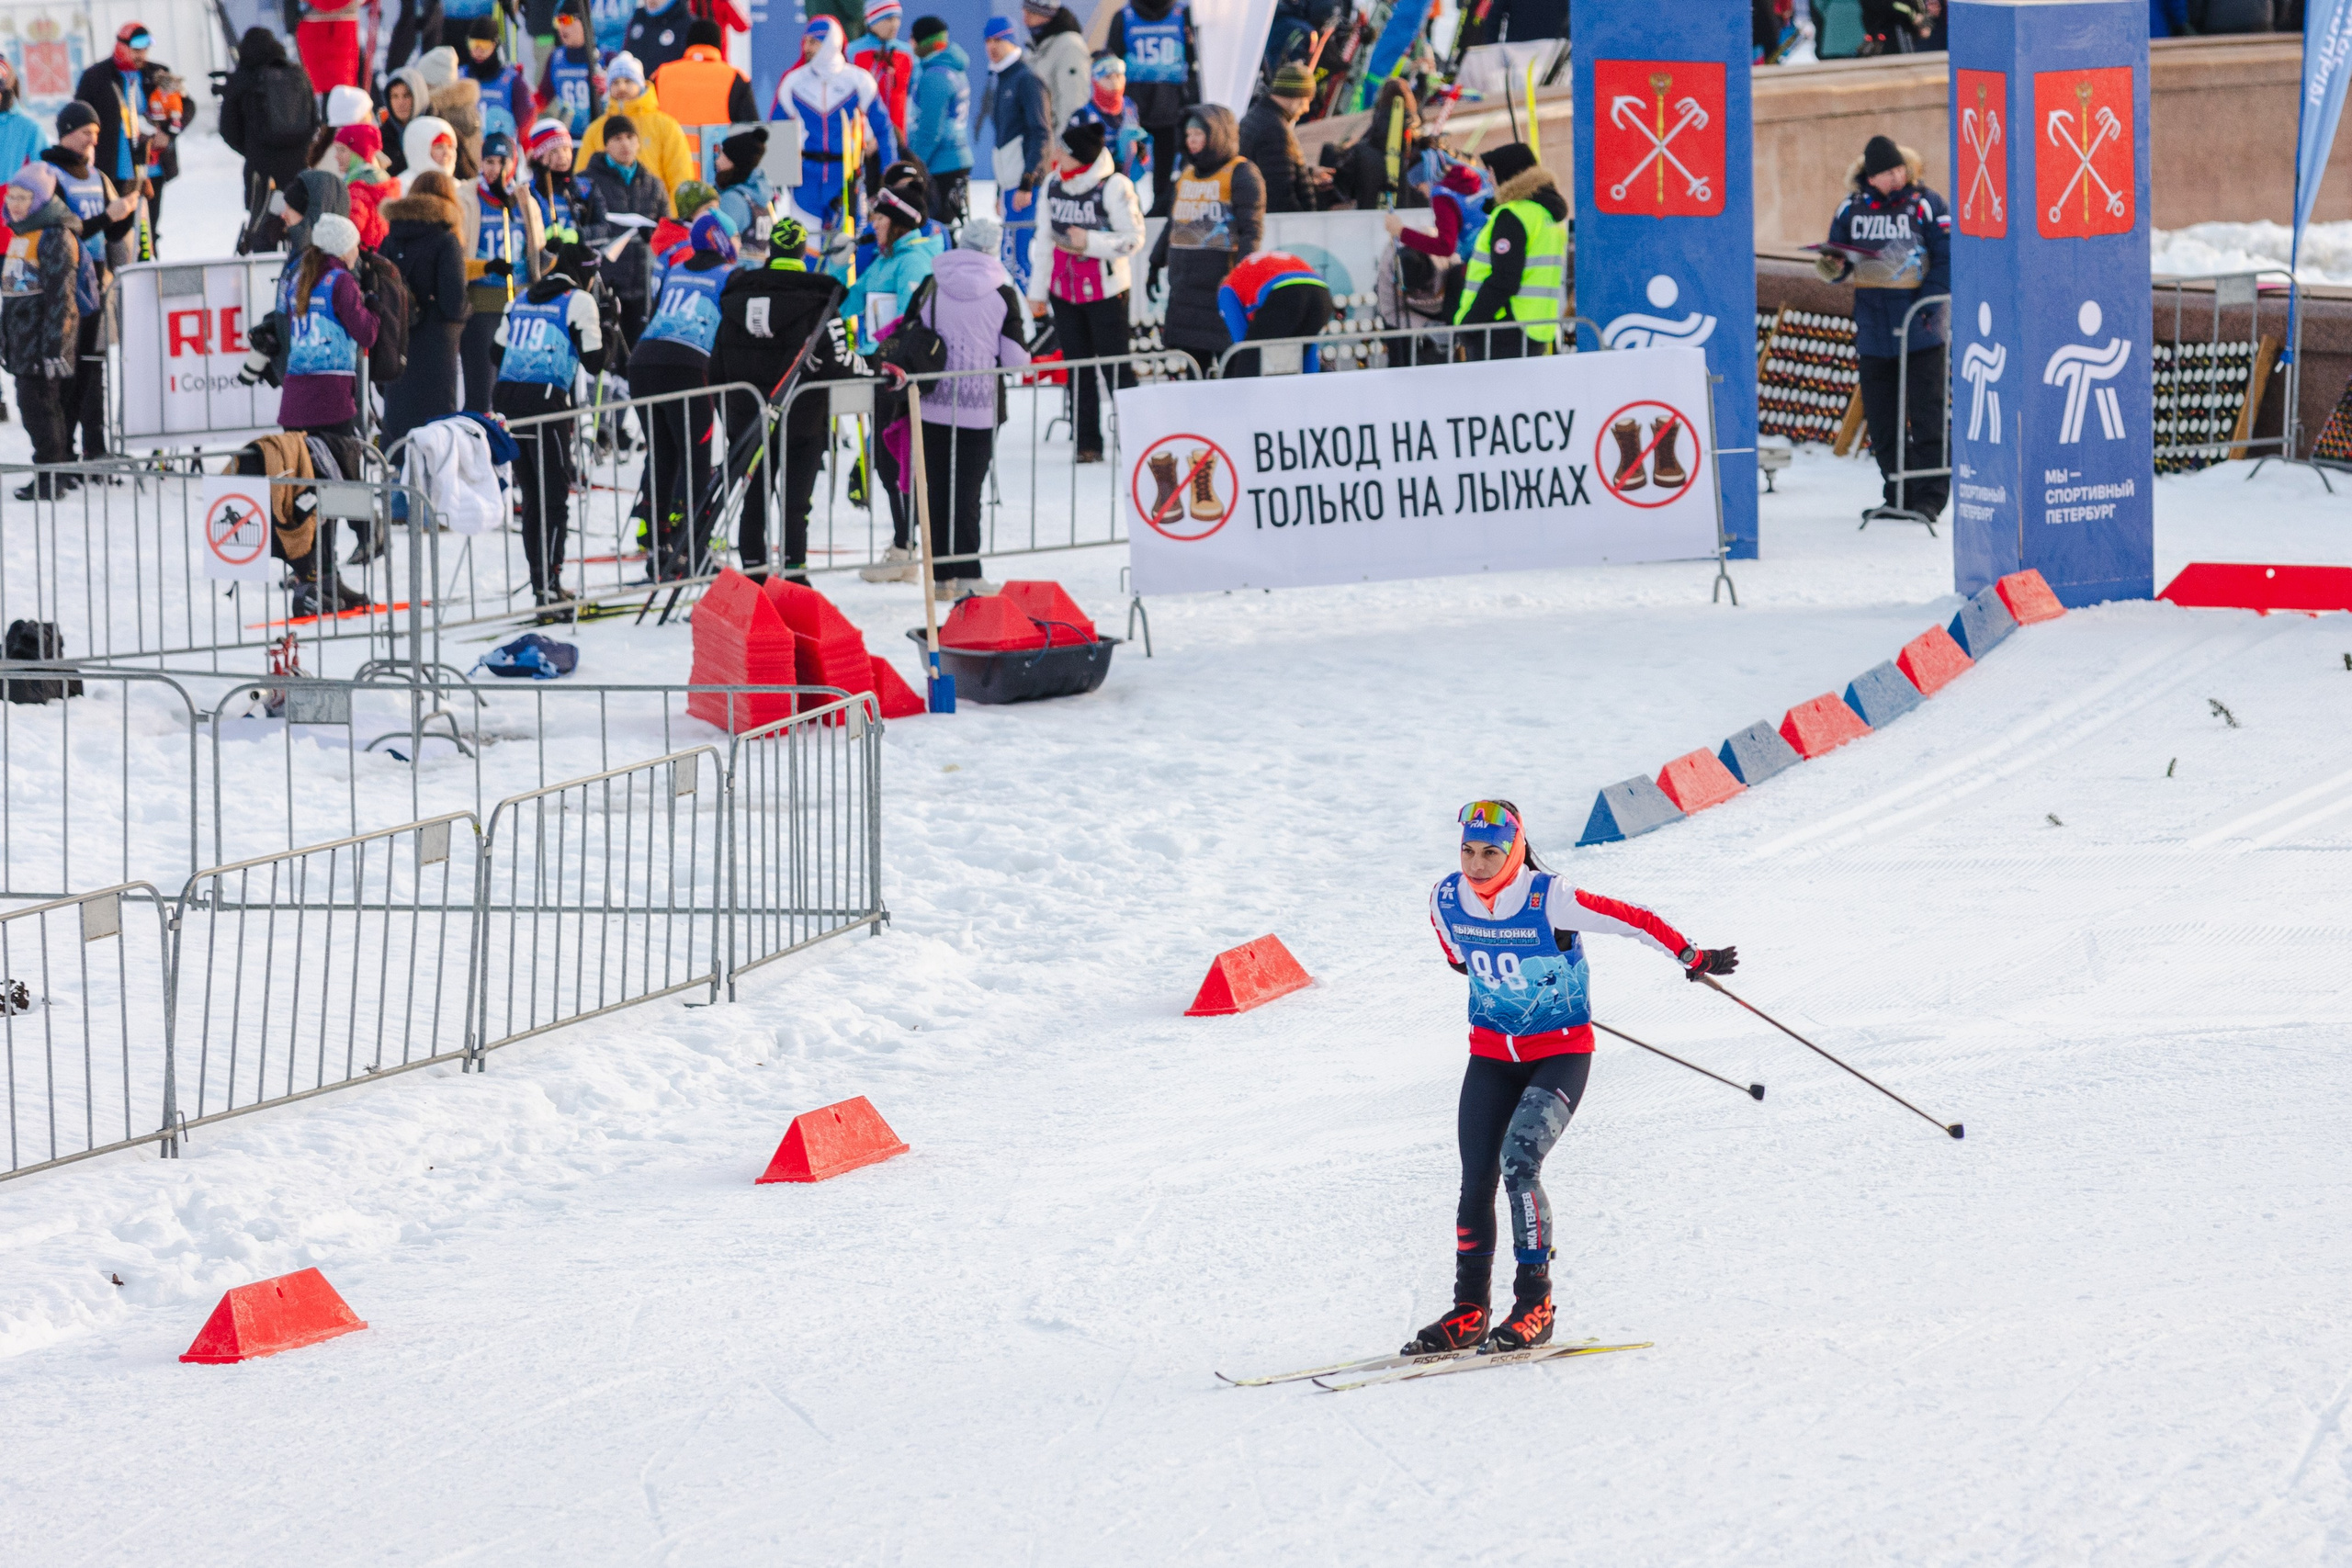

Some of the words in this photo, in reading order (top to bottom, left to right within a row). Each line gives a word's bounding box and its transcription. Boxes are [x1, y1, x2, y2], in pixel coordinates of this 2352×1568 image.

[1134, 37, 1175, 65] 150
[561, 80, 590, 111] 69
[1850, 213, 1911, 240] СУДЬЯ
[662, 288, 701, 321] 114
[511, 317, 548, 351] 119
[1253, 423, 1382, 473] ВЫХОД
[1391, 420, 1439, 463] НА
[1446, 410, 1576, 457] ТРАССУ
[2044, 468, 2068, 485] МЫ
[1247, 479, 1385, 529] ТОЛЬКО
[1397, 476, 1443, 518] НА
[1454, 464, 1591, 514] ЛЫЖАХ
[2044, 479, 2135, 504] СПОРТИВНЫЙ
[2045, 503, 2117, 525] ПЕТЕРБУРГ
[1499, 930, 1536, 938] ГОНКИ
[1521, 1191, 1537, 1228] ГЕРОЕВ
[1412, 1352, 1461, 1366] FISCHER
[1489, 1352, 1532, 1365] FISCHER
